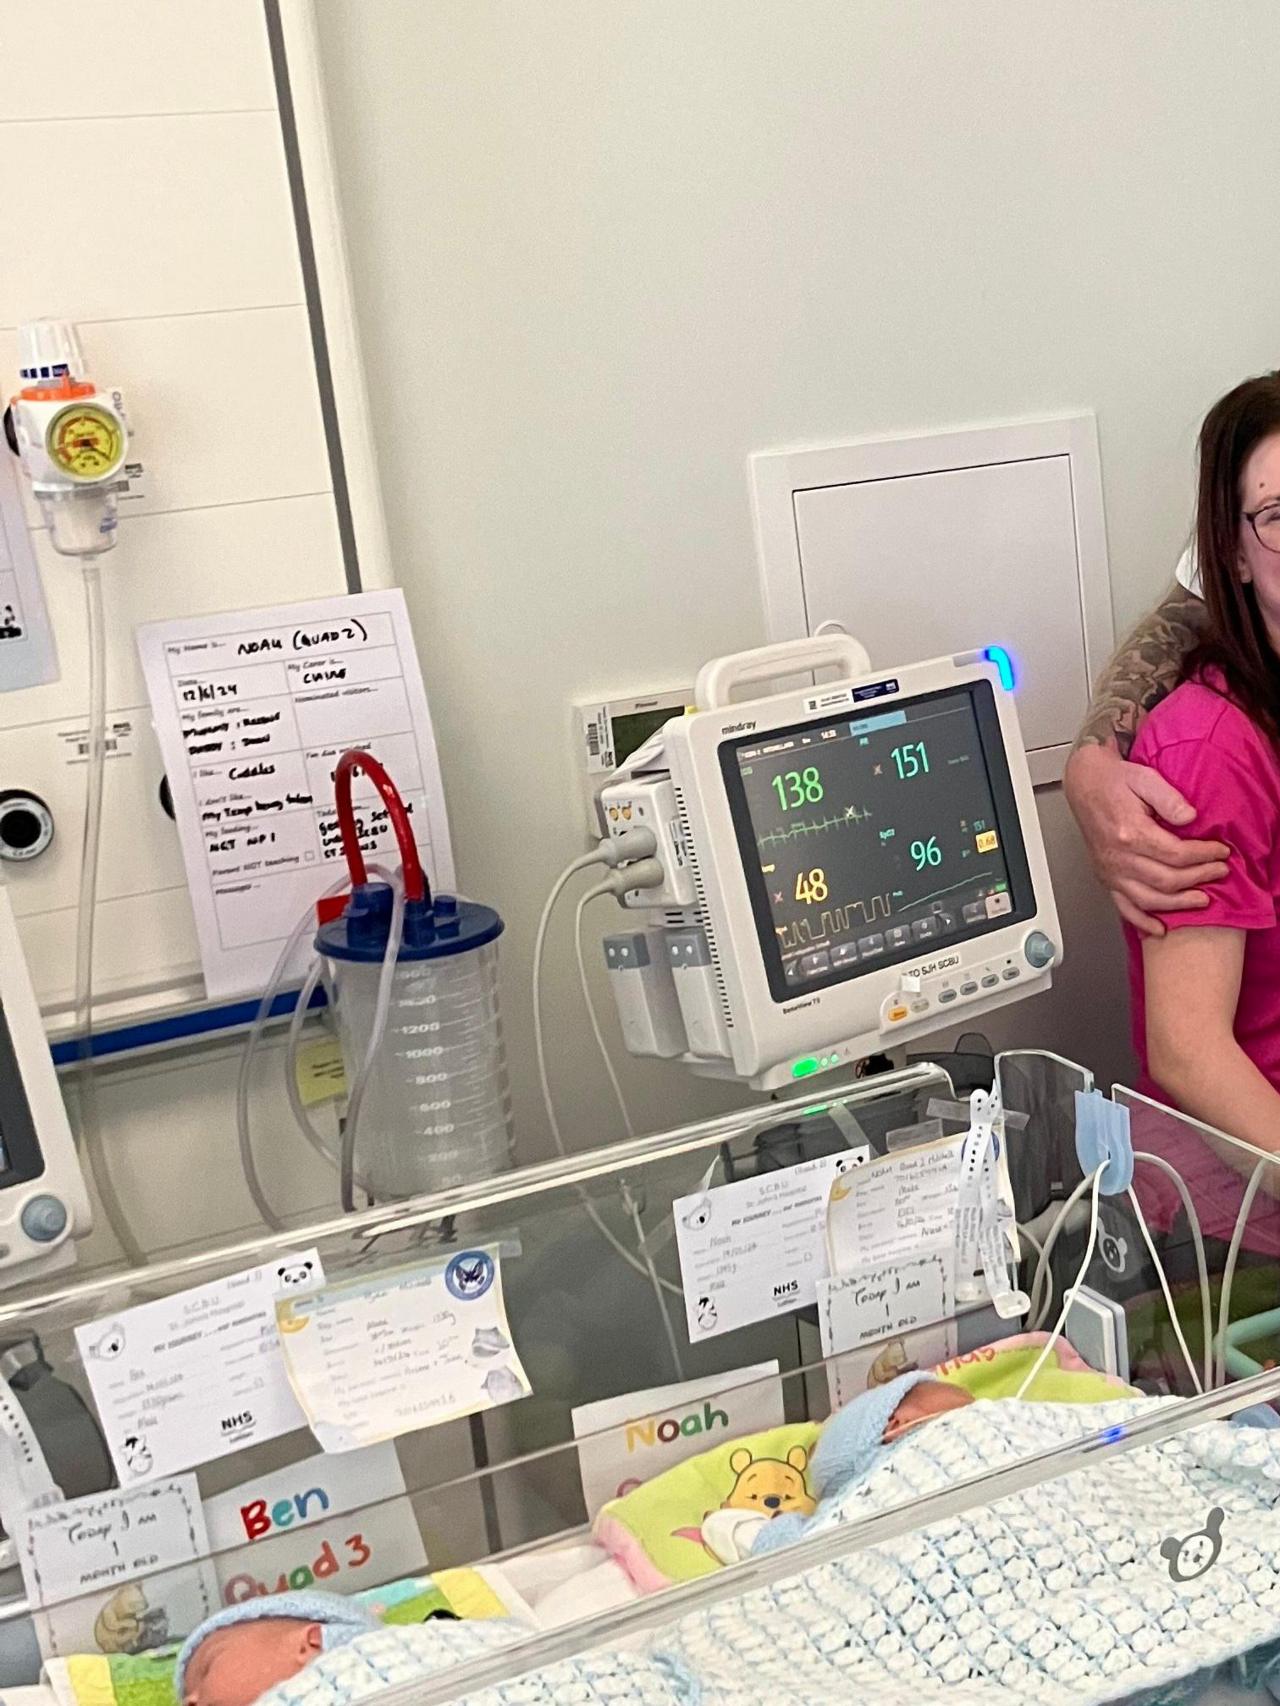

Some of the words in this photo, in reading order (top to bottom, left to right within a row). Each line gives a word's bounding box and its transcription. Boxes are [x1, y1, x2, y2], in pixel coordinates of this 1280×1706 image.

[721, 720, 757, 735] mindray
[890, 741, 930, 780] 151
[771, 767, 824, 812] 138
[910, 836, 942, 871] 96
[795, 868, 829, 905] 48
[773, 1279, 799, 1296] NHS
[221, 1410, 254, 1431] NHS
[625, 1401, 730, 1452] Noah
[240, 1486, 330, 1541] Ben
[224, 1540, 340, 1604] Quad
[345, 1533, 372, 1568] 3
